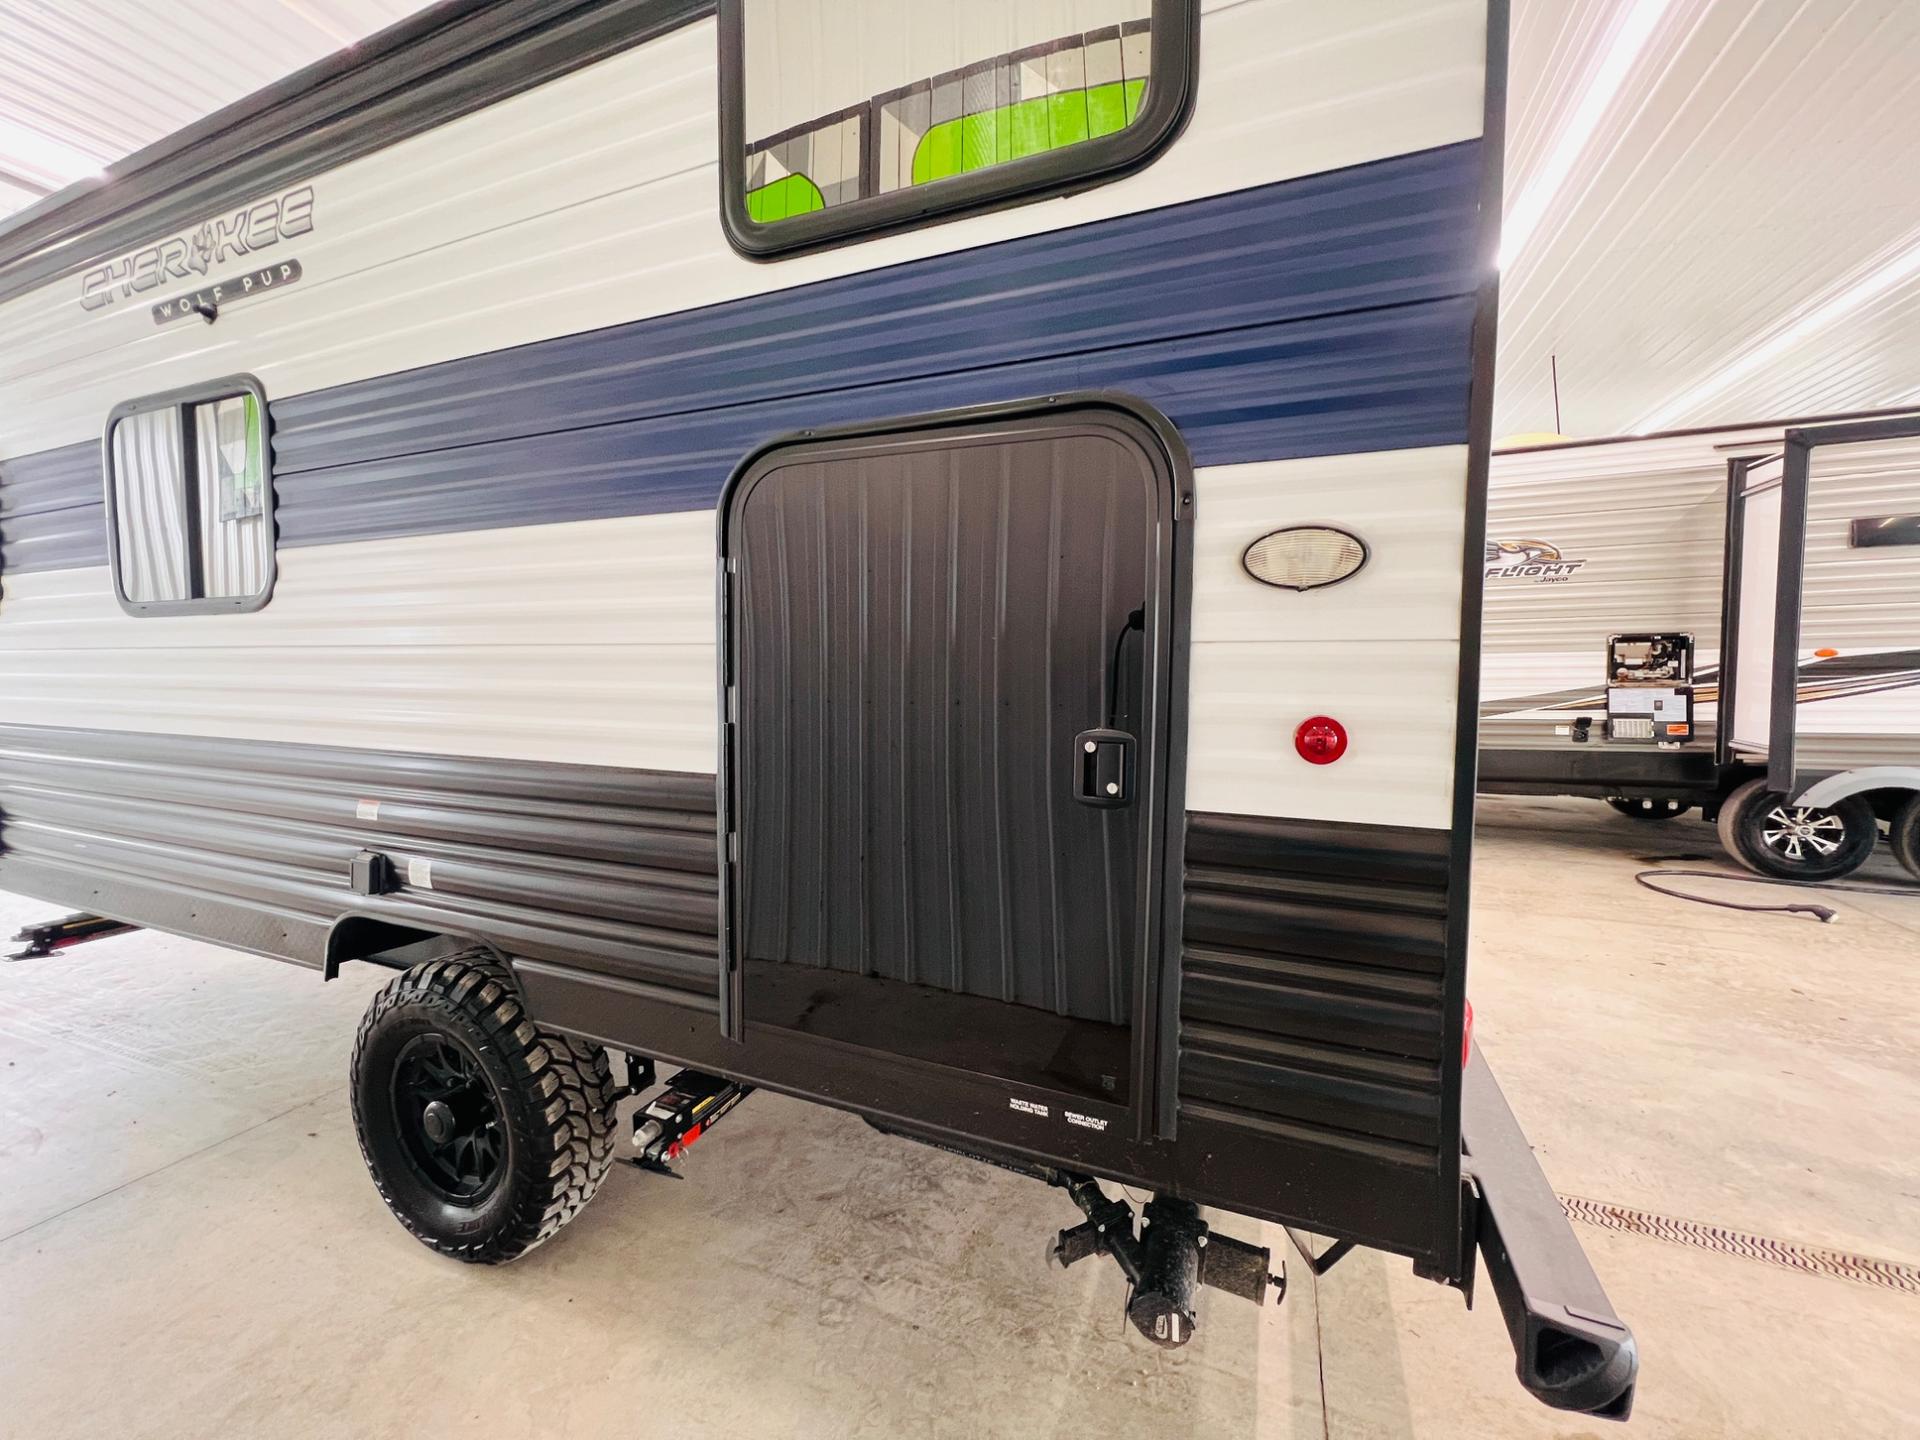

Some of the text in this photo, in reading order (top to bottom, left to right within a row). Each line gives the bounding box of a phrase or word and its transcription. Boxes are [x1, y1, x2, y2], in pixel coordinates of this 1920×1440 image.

[159, 264, 291, 317] WOLF PUP
[1485, 564, 1582, 578] FLIGHT
[1065, 1111, 1108, 1126] SEWER OUTLET
[1067, 1118, 1104, 1131] CONNECTION
